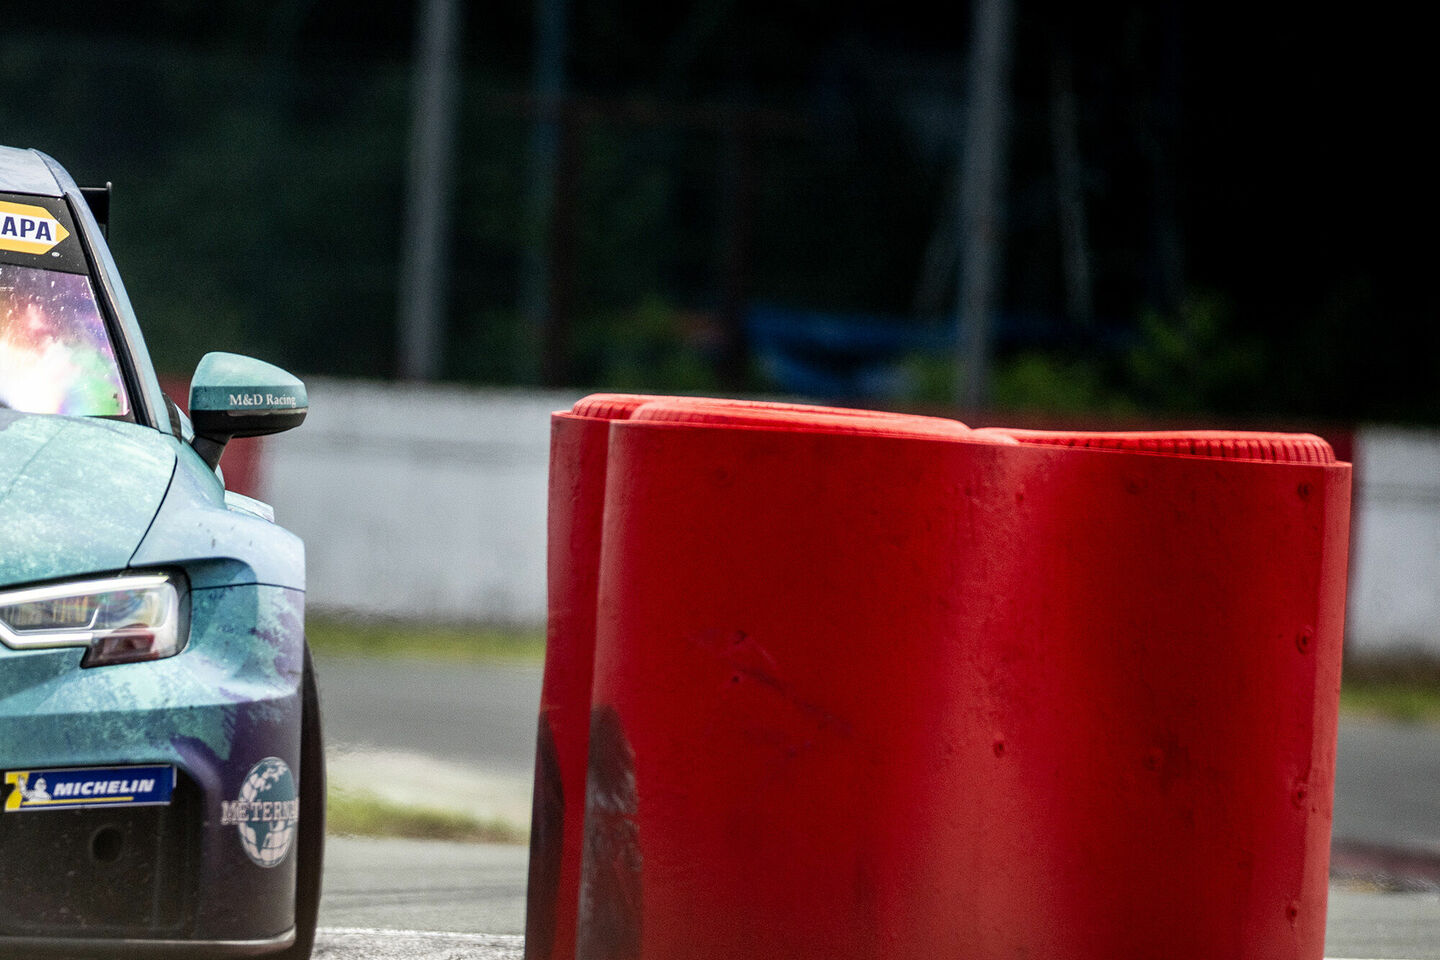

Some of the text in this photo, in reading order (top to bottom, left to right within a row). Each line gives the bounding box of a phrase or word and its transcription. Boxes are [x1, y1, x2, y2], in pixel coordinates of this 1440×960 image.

[229, 393, 297, 409] M&D Racing
[53, 779, 156, 797] MICHELIN
